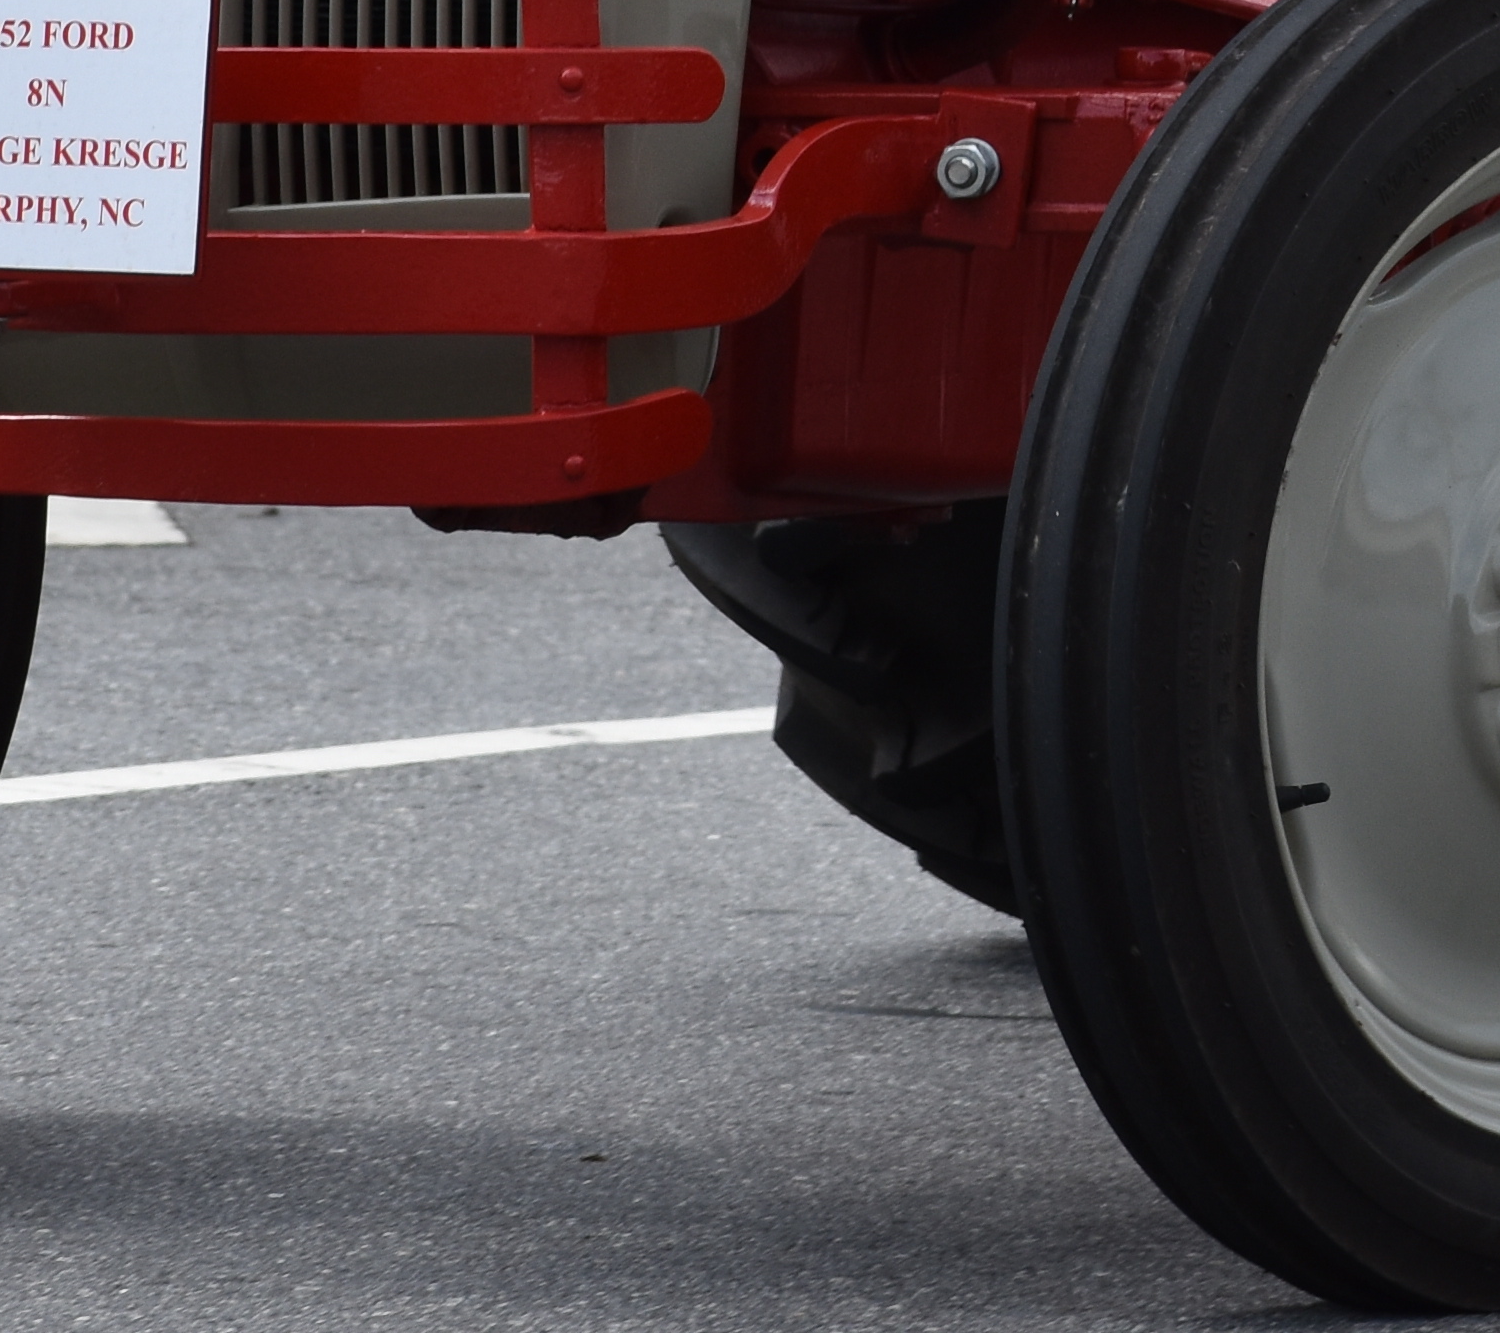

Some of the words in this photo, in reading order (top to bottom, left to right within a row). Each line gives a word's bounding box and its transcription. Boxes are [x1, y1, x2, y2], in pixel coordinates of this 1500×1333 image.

[42, 20, 134, 51] FORD
[27, 79, 67, 107] 8N
[52, 137, 189, 170] KRESGE
[97, 198, 145, 227] NC
